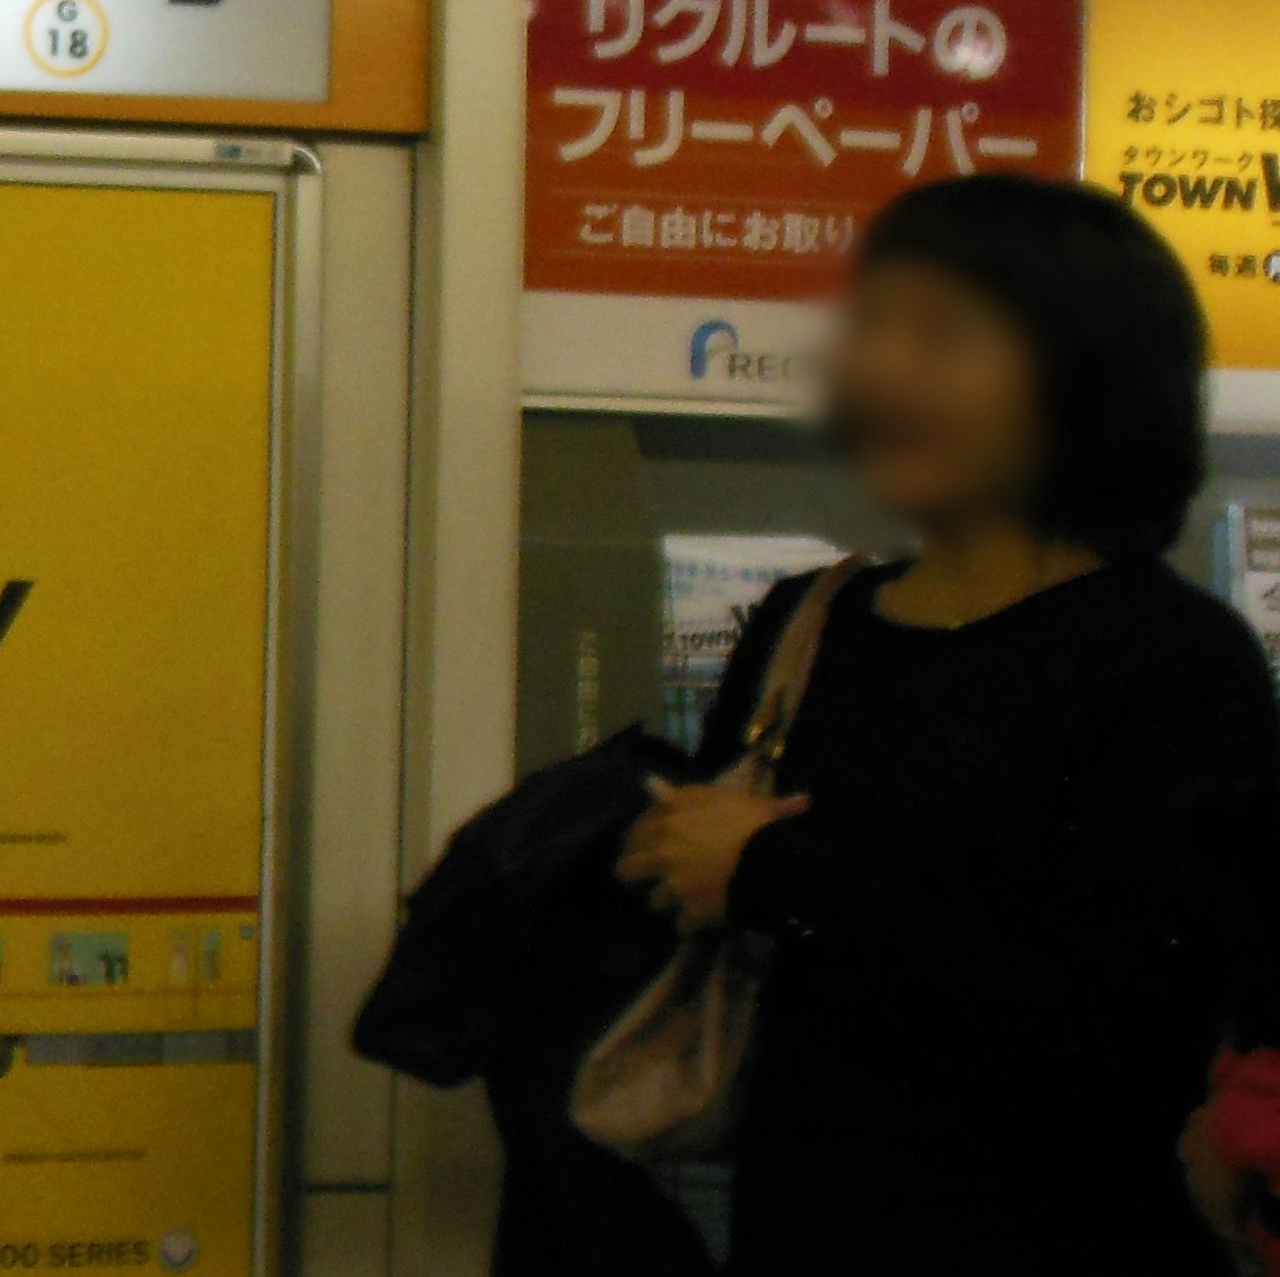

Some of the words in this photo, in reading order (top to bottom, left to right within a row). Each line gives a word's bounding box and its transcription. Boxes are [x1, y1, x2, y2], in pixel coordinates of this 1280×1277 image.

[56, 0, 79, 23] G
[47, 29, 88, 60] 18
[553, 87, 1038, 178] フリーペーパー
[48, 1239, 150, 1268] SERIES
